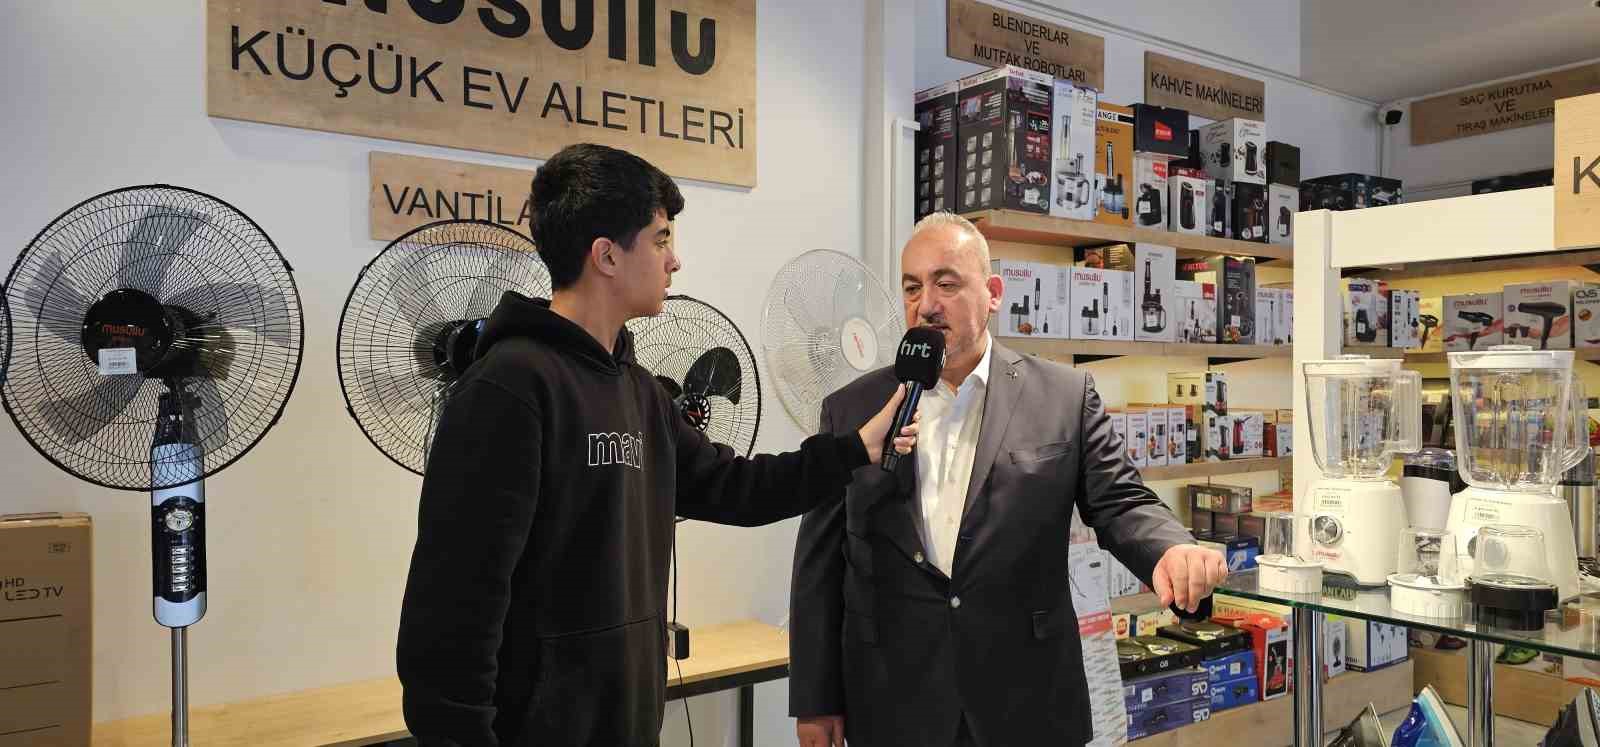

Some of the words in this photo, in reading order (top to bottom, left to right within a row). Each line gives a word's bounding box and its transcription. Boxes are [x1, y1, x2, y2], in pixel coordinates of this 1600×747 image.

[321, 0, 716, 75] sullu
[992, 12, 1069, 46] BLENDERLAR
[1024, 39, 1040, 55] VE
[974, 44, 1021, 67] MUTFAK
[1024, 55, 1087, 81] ROBOTLARI
[231, 25, 444, 102] KÜÇÜK
[463, 66, 529, 114] EV
[540, 81, 744, 150] ALETLERİ
[1151, 71, 1193, 97] KAHVE
[1196, 85, 1263, 114] MAKİNELERİ
[1459, 94, 1485, 106] SAÇ
[1487, 79, 1553, 101] KURUTMA
[1494, 98, 1517, 113] VE
[900, 340, 931, 358] hrt
[41, 585, 64, 598] TV
